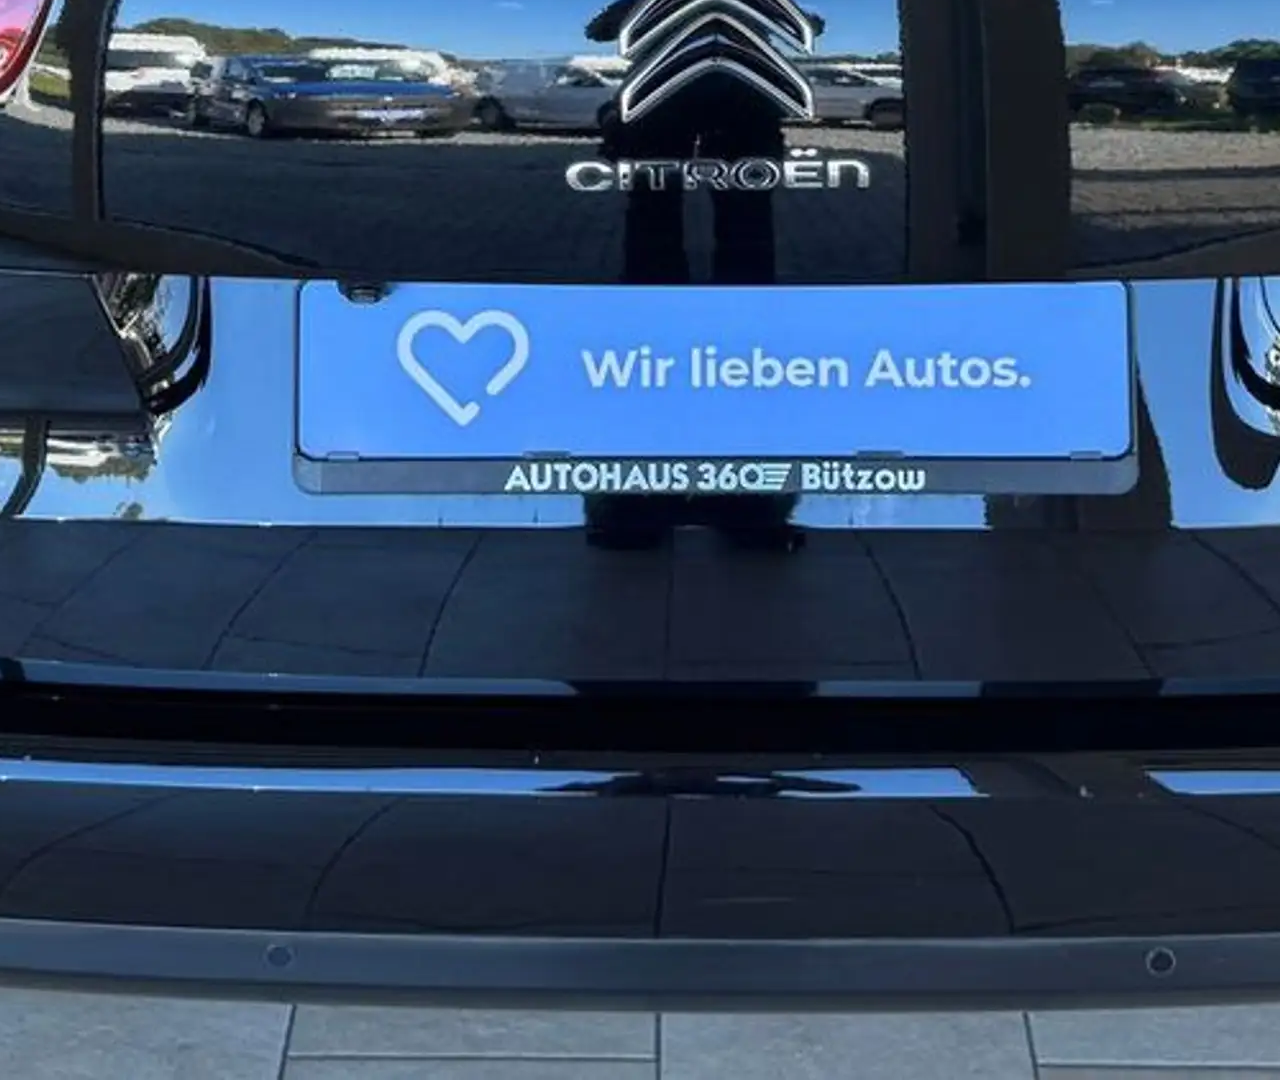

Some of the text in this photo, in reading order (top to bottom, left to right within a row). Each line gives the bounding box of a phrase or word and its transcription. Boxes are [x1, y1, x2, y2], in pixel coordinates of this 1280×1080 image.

[581, 346, 1033, 389] Wir lieben Autos.
[504, 463, 688, 491] AUTOHAUS
[801, 461, 926, 491] Bützow
